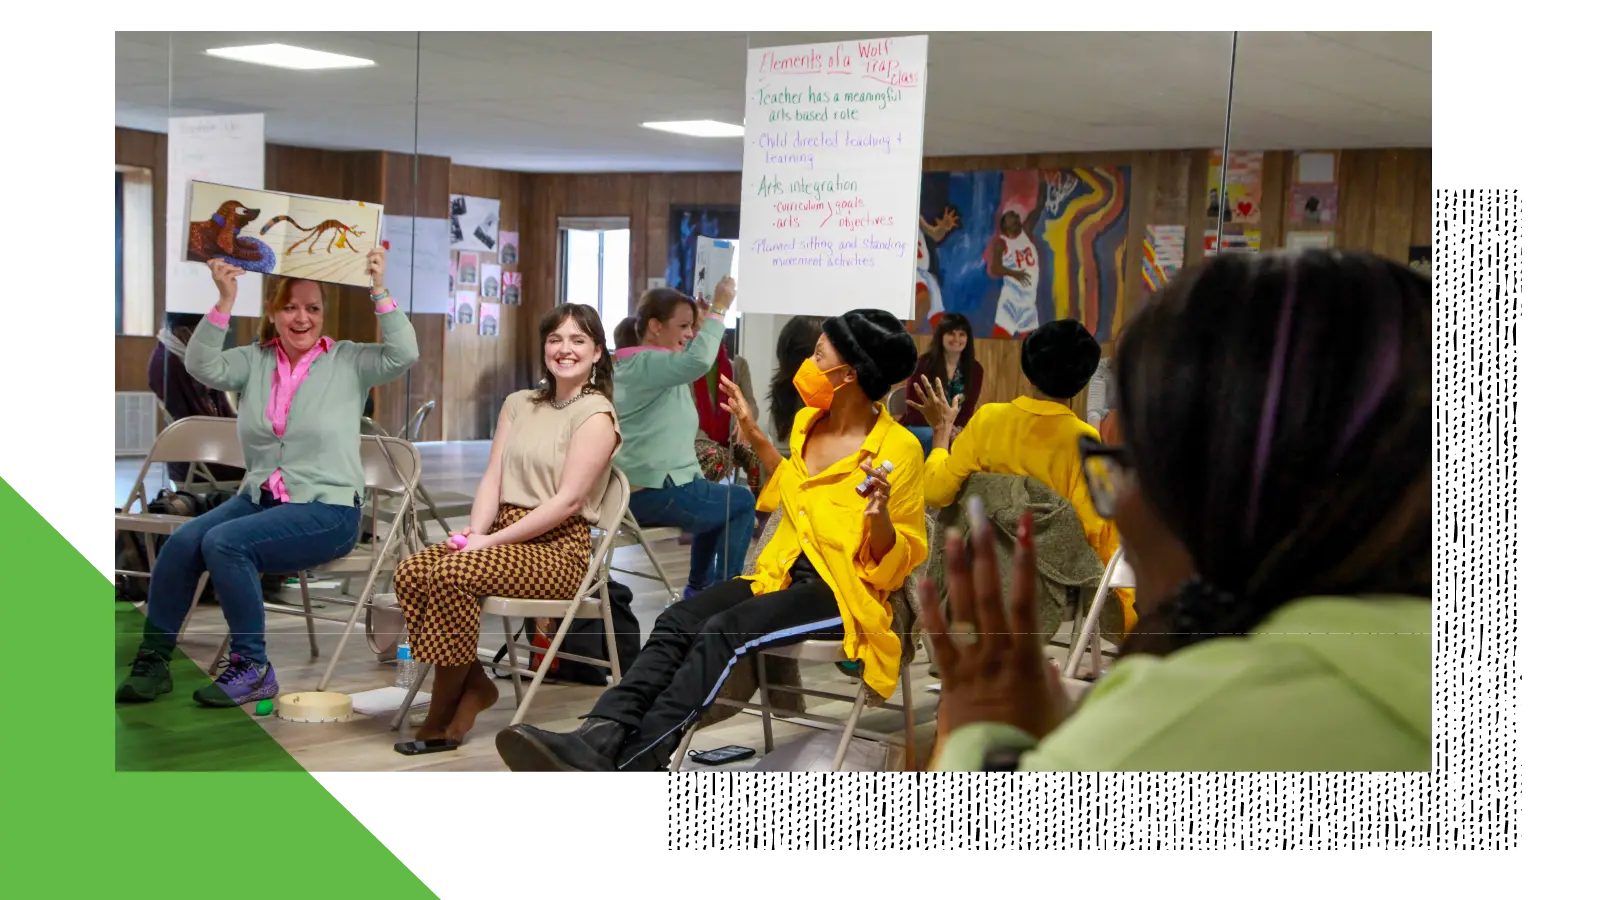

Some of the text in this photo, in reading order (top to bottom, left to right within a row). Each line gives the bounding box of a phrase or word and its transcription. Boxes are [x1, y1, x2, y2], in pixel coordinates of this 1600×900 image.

[759, 39, 893, 73] Elements of a Wolf
[863, 59, 900, 78] Trap
[890, 70, 918, 86] class
[758, 84, 901, 109] Teacher has a meaningful
[769, 107, 858, 122] arts based role
[759, 131, 787, 148] Child
[793, 131, 838, 148] directed
[845, 132, 890, 153] teaching
[757, 173, 858, 200] Arts integration
[777, 198, 865, 215] curriculum goals
[777, 214, 893, 231] arts objectives
[754, 238, 796, 254] Planned
[801, 236, 833, 256] sitting
[839, 236, 857, 250] and
[772, 254, 875, 267] movement activities
